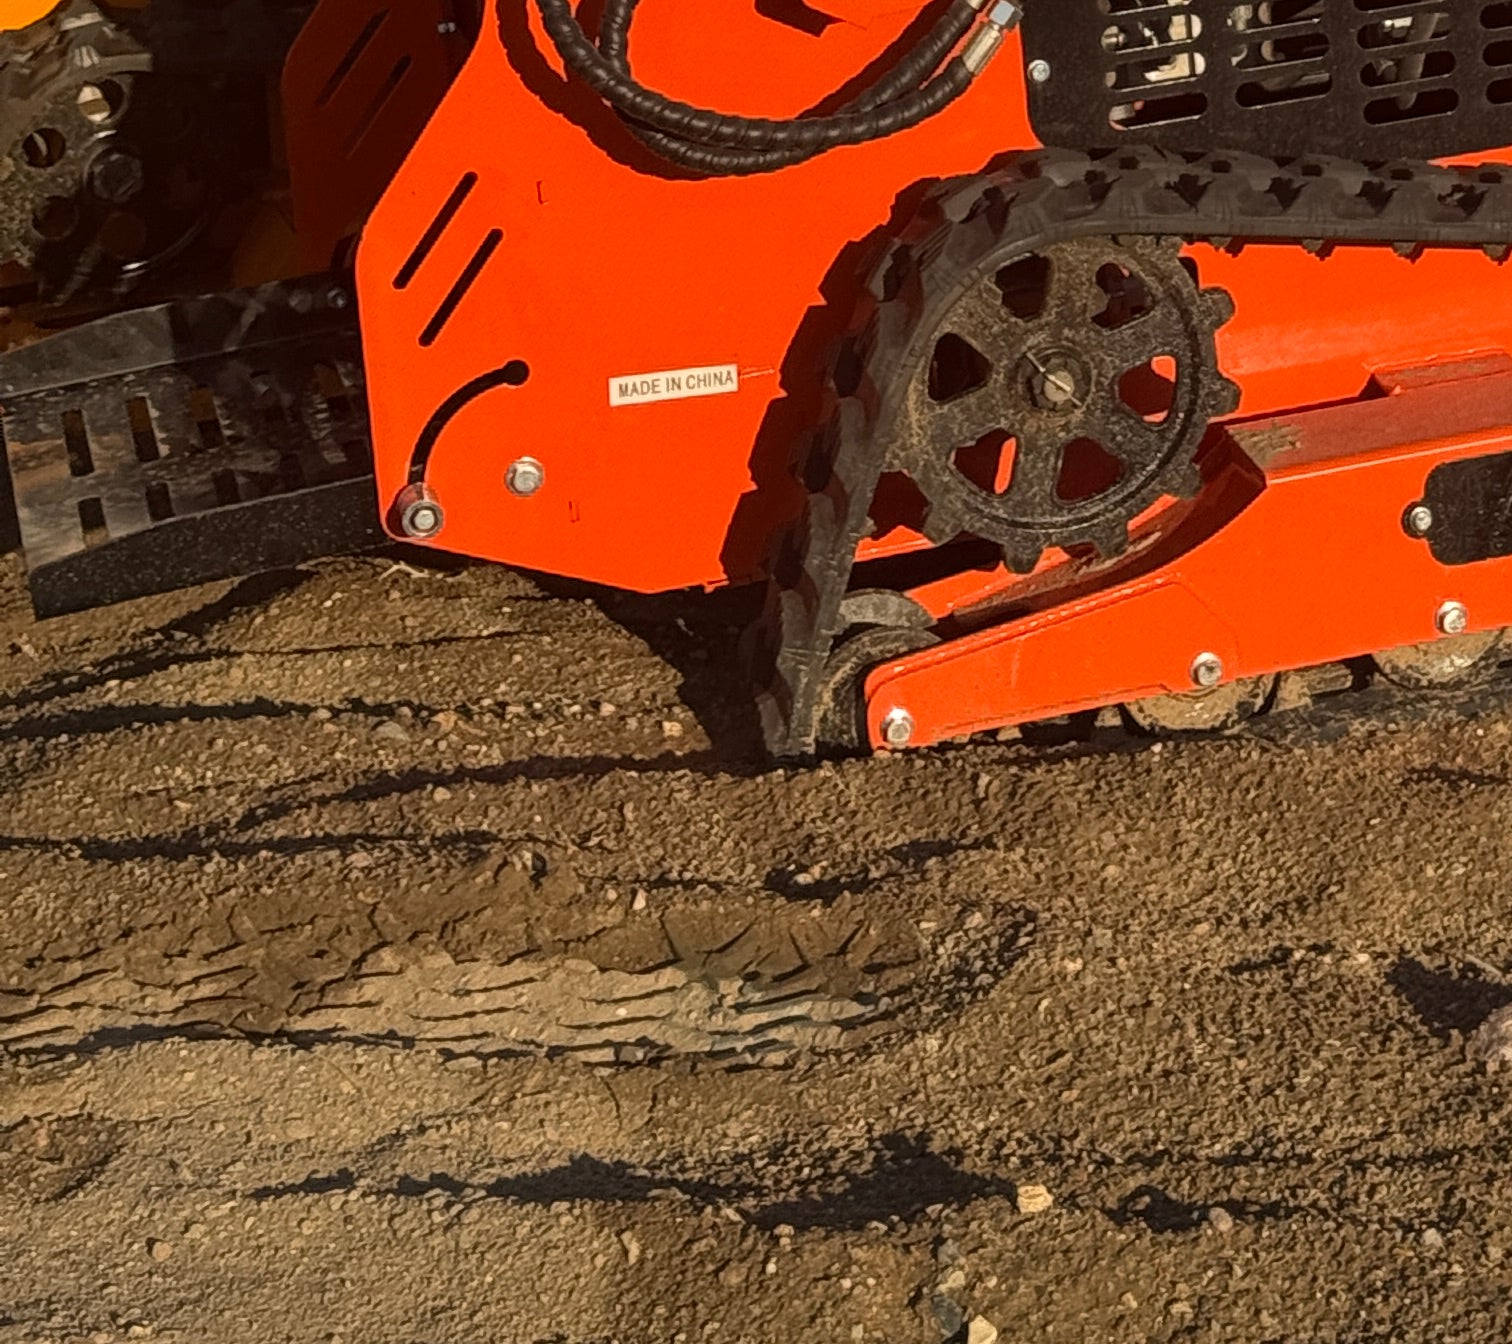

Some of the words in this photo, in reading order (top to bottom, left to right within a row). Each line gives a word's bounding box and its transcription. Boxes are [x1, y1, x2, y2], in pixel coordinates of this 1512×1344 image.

[618, 378, 661, 398] MADE
[666, 377, 682, 393] IN
[685, 370, 734, 390] CHINA
